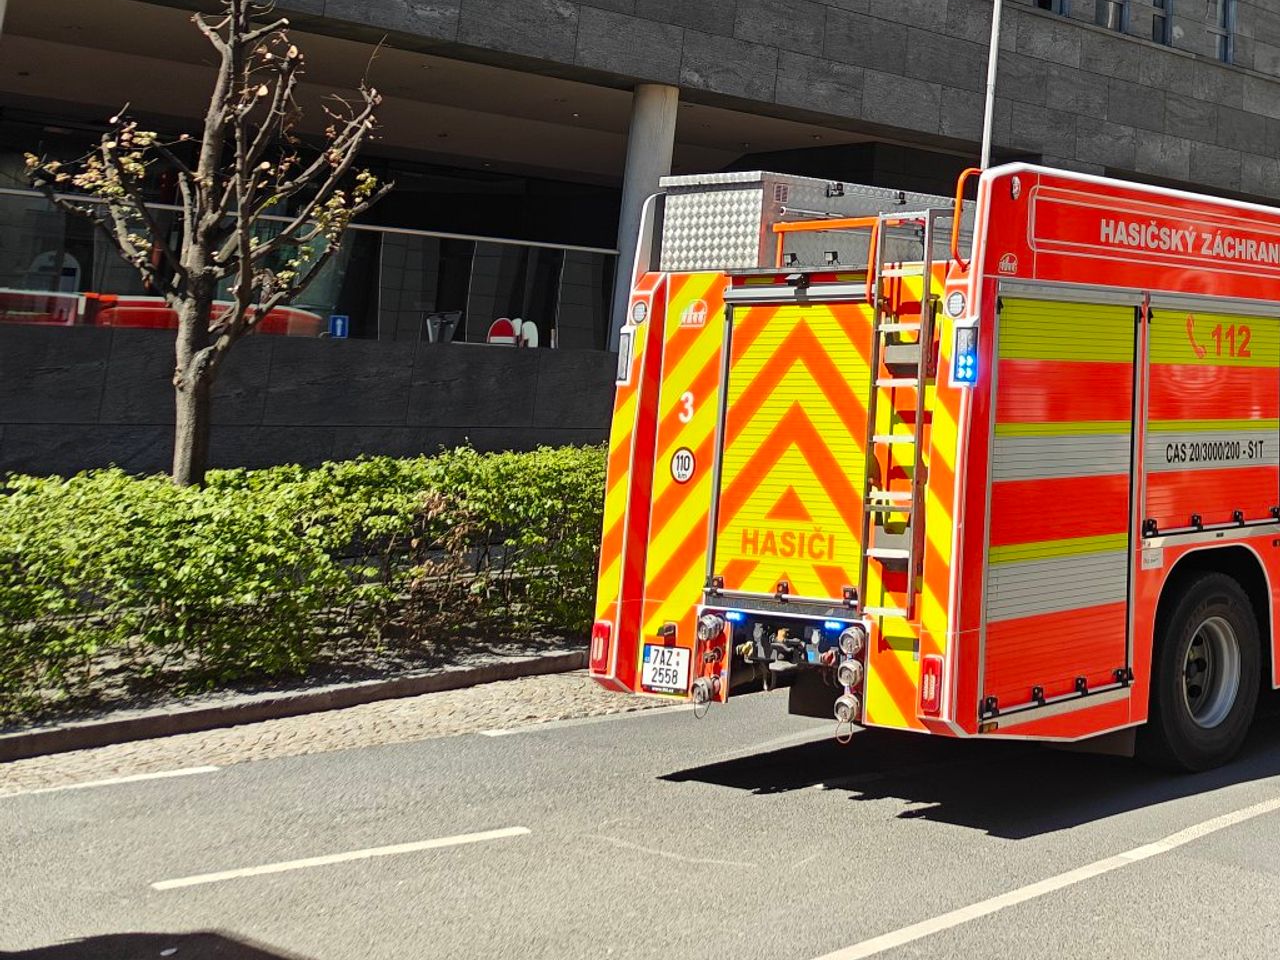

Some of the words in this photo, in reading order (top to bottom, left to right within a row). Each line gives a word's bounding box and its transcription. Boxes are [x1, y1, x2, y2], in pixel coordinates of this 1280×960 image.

[1100, 218, 1197, 253] HASIČSKÝ
[1211, 323, 1252, 358] 112
[678, 391, 694, 424] 3
[676, 454, 691, 471] 110
[1166, 443, 1187, 463] CAS
[1189, 441, 1240, 462] 20/3000/200
[741, 526, 835, 560] HASIČI
[652, 648, 673, 666] 7AZ
[651, 667, 679, 685] 2558
